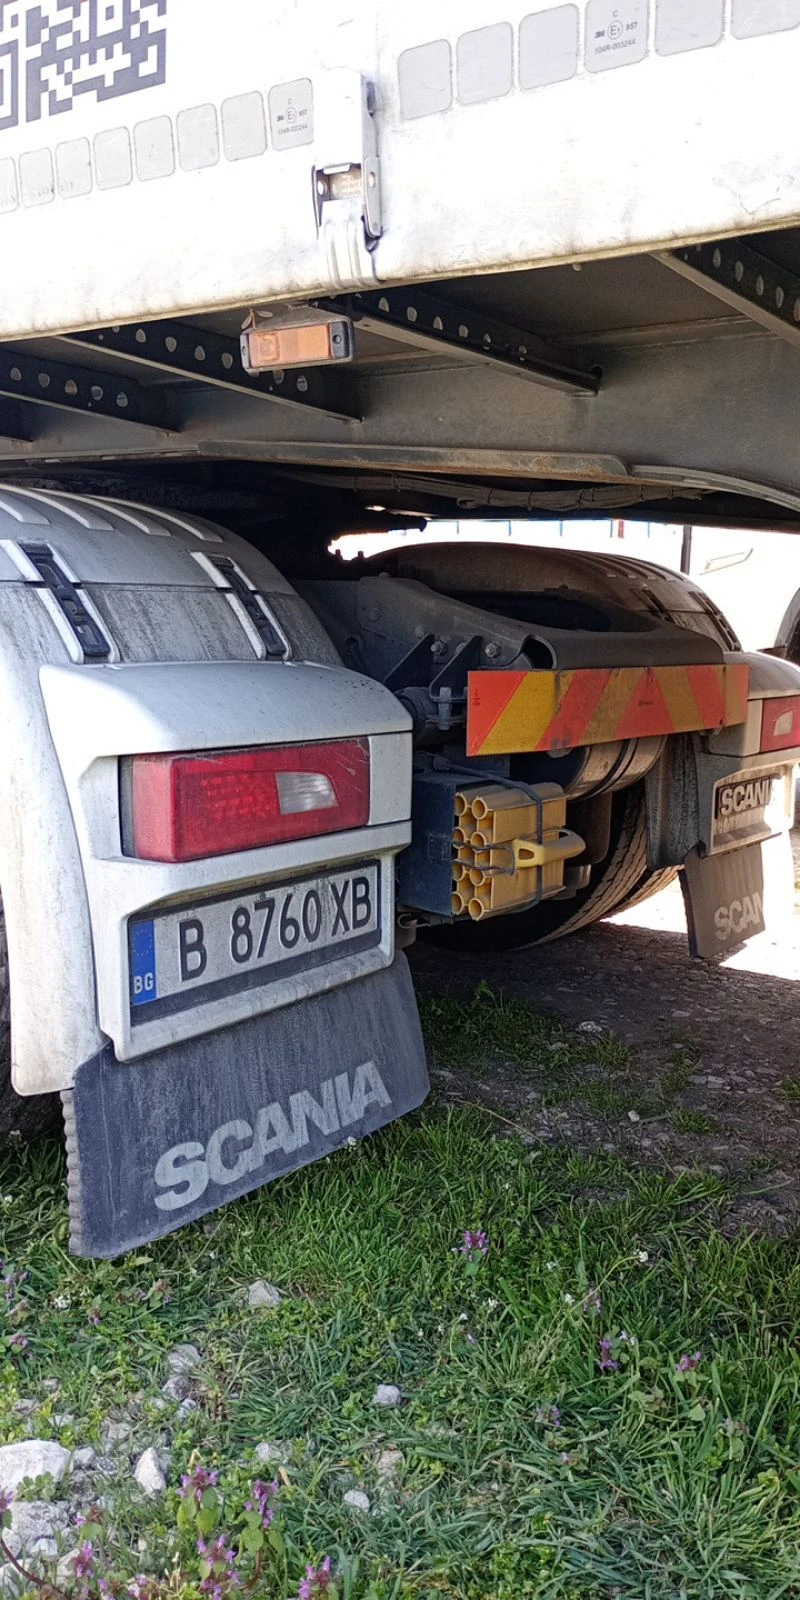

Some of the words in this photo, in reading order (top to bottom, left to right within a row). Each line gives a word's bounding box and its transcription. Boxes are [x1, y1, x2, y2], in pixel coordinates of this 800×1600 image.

[179, 918, 208, 982] B
[230, 888, 322, 964] 8760
[331, 876, 371, 937] XB
[133, 972, 154, 994] BG
[154, 1060, 392, 1211] SCANIA
